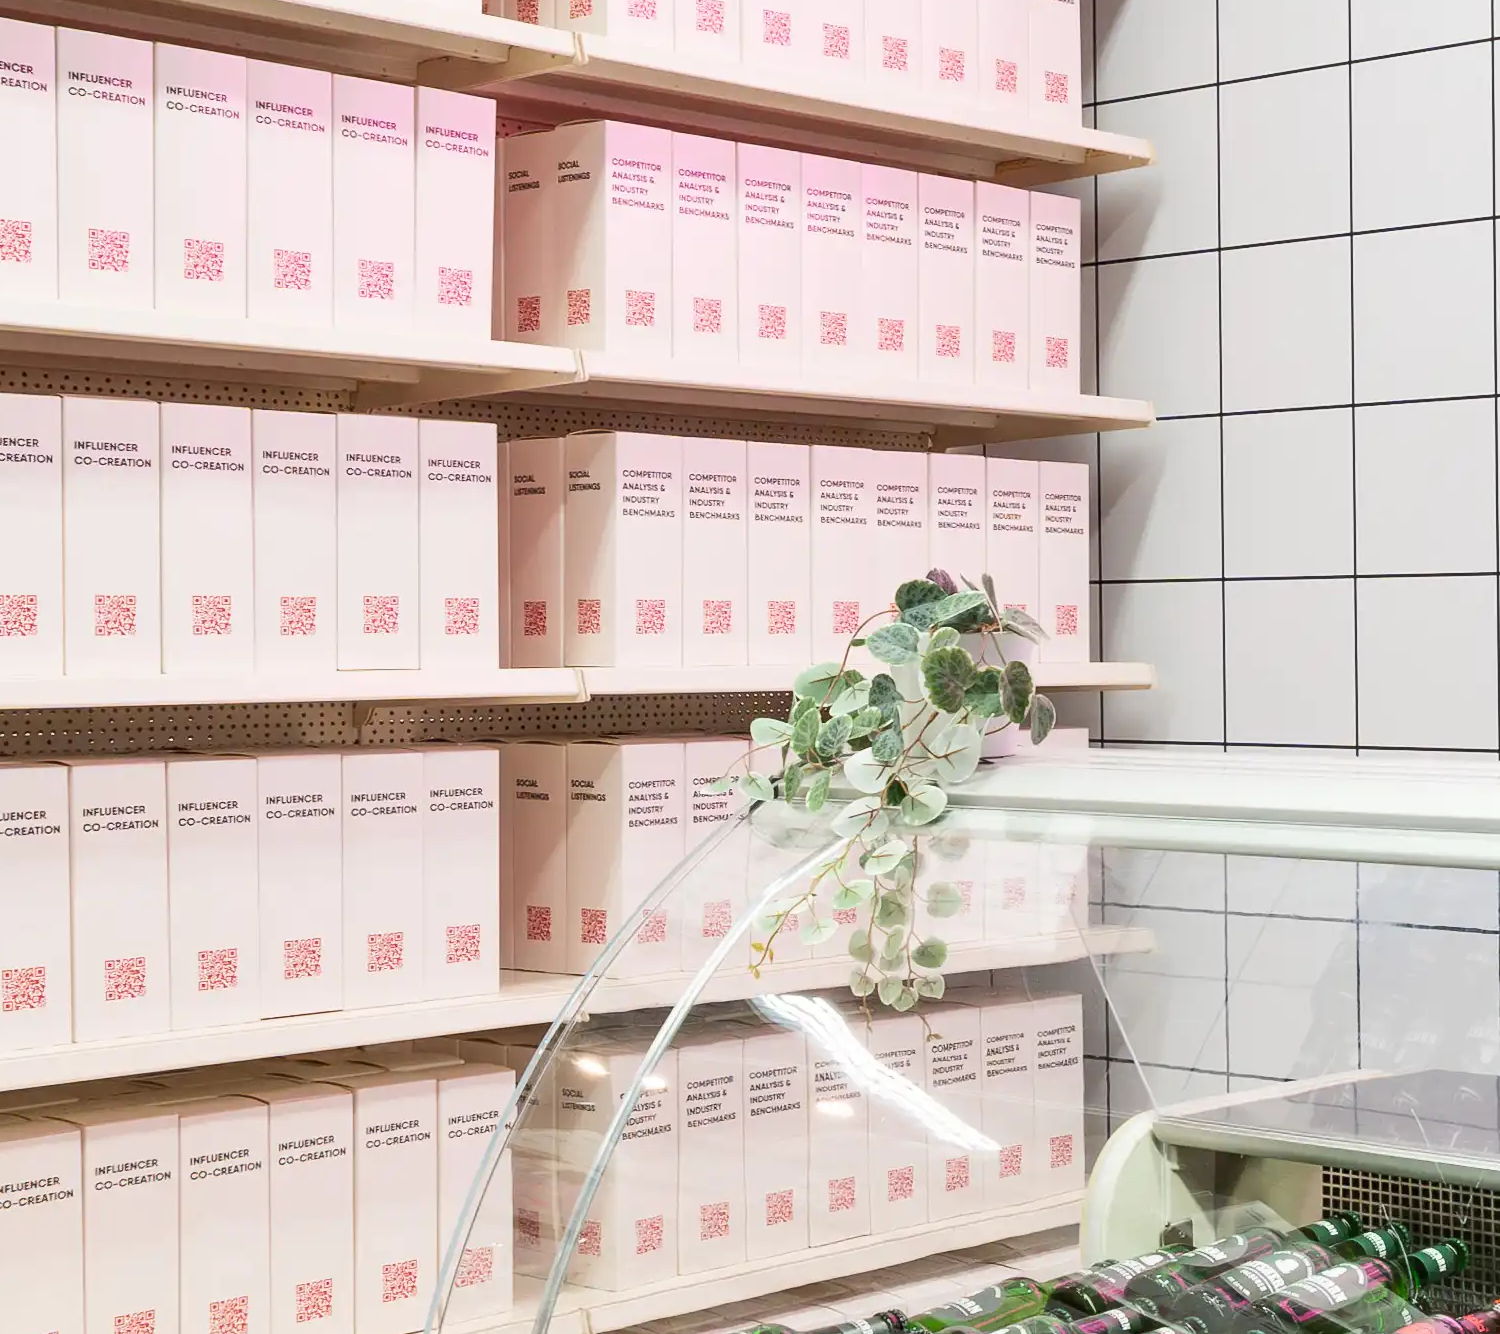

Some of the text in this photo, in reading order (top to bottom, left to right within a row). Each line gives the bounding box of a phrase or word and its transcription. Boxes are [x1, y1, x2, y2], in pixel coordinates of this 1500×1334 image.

[165, 85, 228, 103] INFLUENCER
[165, 100, 240, 120] CO-CREATION
[557, 160, 581, 171] SOCIAL
[611, 157, 662, 173] COMPETITOR
[557, 171, 591, 184] LISTENINGS
[611, 170, 648, 184] ANALYSIS
[611, 183, 649, 196] INDUSTRY
[744, 178, 792, 192] COMPETITOR
[744, 190, 779, 203] ANALYSIS
[611, 196, 665, 212] BENCHMARKS
[744, 203, 780, 215] INDUSTRY
[744, 215, 795, 230] BENCHMARKS
[73, 440, 139, 452] INFLUENCER
[73, 455, 152, 468] CO-CREATION
[345, 453, 402, 464] INFLUENCER
[345, 467, 412, 479] CO-CREATION
[568, 470, 591, 480] SOCIAL
[688, 473, 737, 484] COMPETITOR
[568, 482, 601, 492] LISTENINGS
[688, 485, 725, 495] ANALYSIS
[688, 498, 725, 507] INDUSTRY
[689, 511, 740, 521] BENCHMARKS
[570, 778, 595, 789] SOCIAL
[628, 778, 676, 790] COMPETITOR
[570, 791, 607, 802] LISTENINGS
[628, 792, 663, 802] ANALYSIS
[178, 800, 239, 812] INFLUENCER
[628, 805, 665, 815] INDUSTRY
[178, 814, 251, 827] CO-CREATION
[628, 816, 679, 828] BENCHMARKS
[686, 1075, 734, 1090] COMPETITOR
[685, 1090, 721, 1103] ANALYSIS
[686, 1102, 723, 1117] INDUSTRY
[687, 1111, 737, 1128] BENCHMARKS
[189, 1148, 250, 1166] INFLUENCER
[189, 1160, 262, 1181] CO-CREATION
